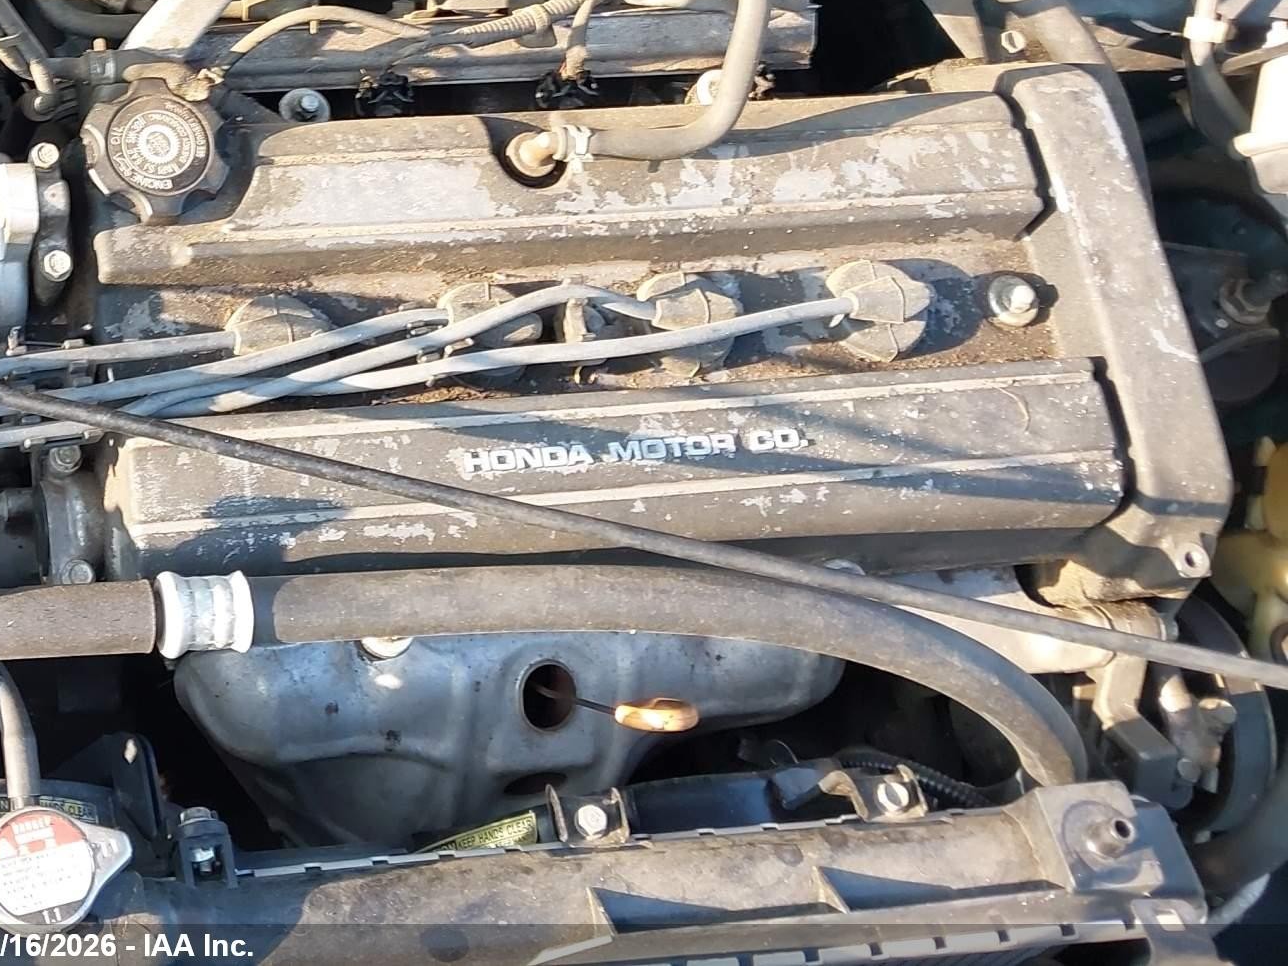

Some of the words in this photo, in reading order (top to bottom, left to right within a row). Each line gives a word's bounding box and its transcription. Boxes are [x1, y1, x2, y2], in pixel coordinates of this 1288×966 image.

[130, 171, 173, 190] ENGINE
[463, 444, 594, 474] HONDA
[608, 433, 737, 462] MOTOR
[748, 427, 810, 452] CO.
[478, 827, 504, 844] HANDS
[506, 816, 533, 836] CLEAR
